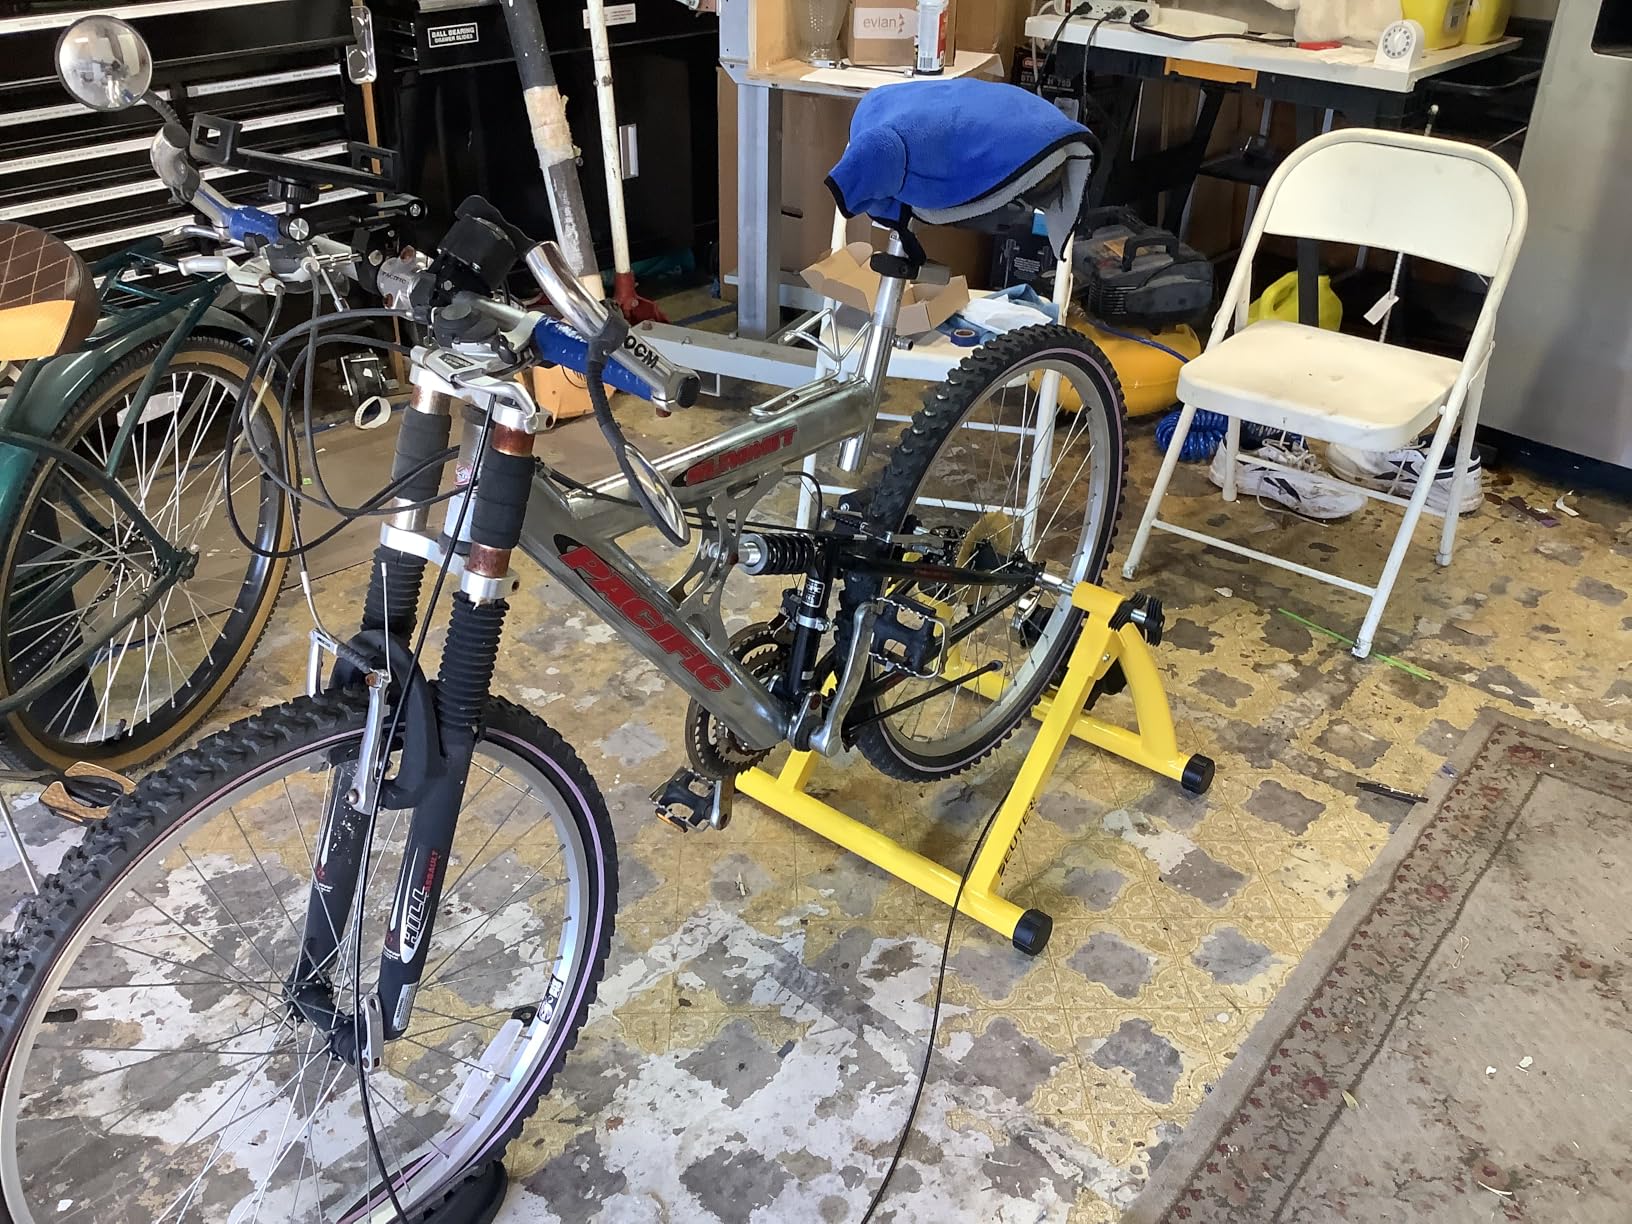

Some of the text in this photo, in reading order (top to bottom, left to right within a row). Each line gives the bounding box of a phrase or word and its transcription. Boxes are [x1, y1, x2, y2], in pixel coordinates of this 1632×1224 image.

[431, 26, 475, 38] BALL BEARING
[863, 17, 897, 29] evian
[685, 424, 798, 488] SUMMIT
[558, 544, 733, 693] PACIFIC
[404, 887, 428, 951] HILL
